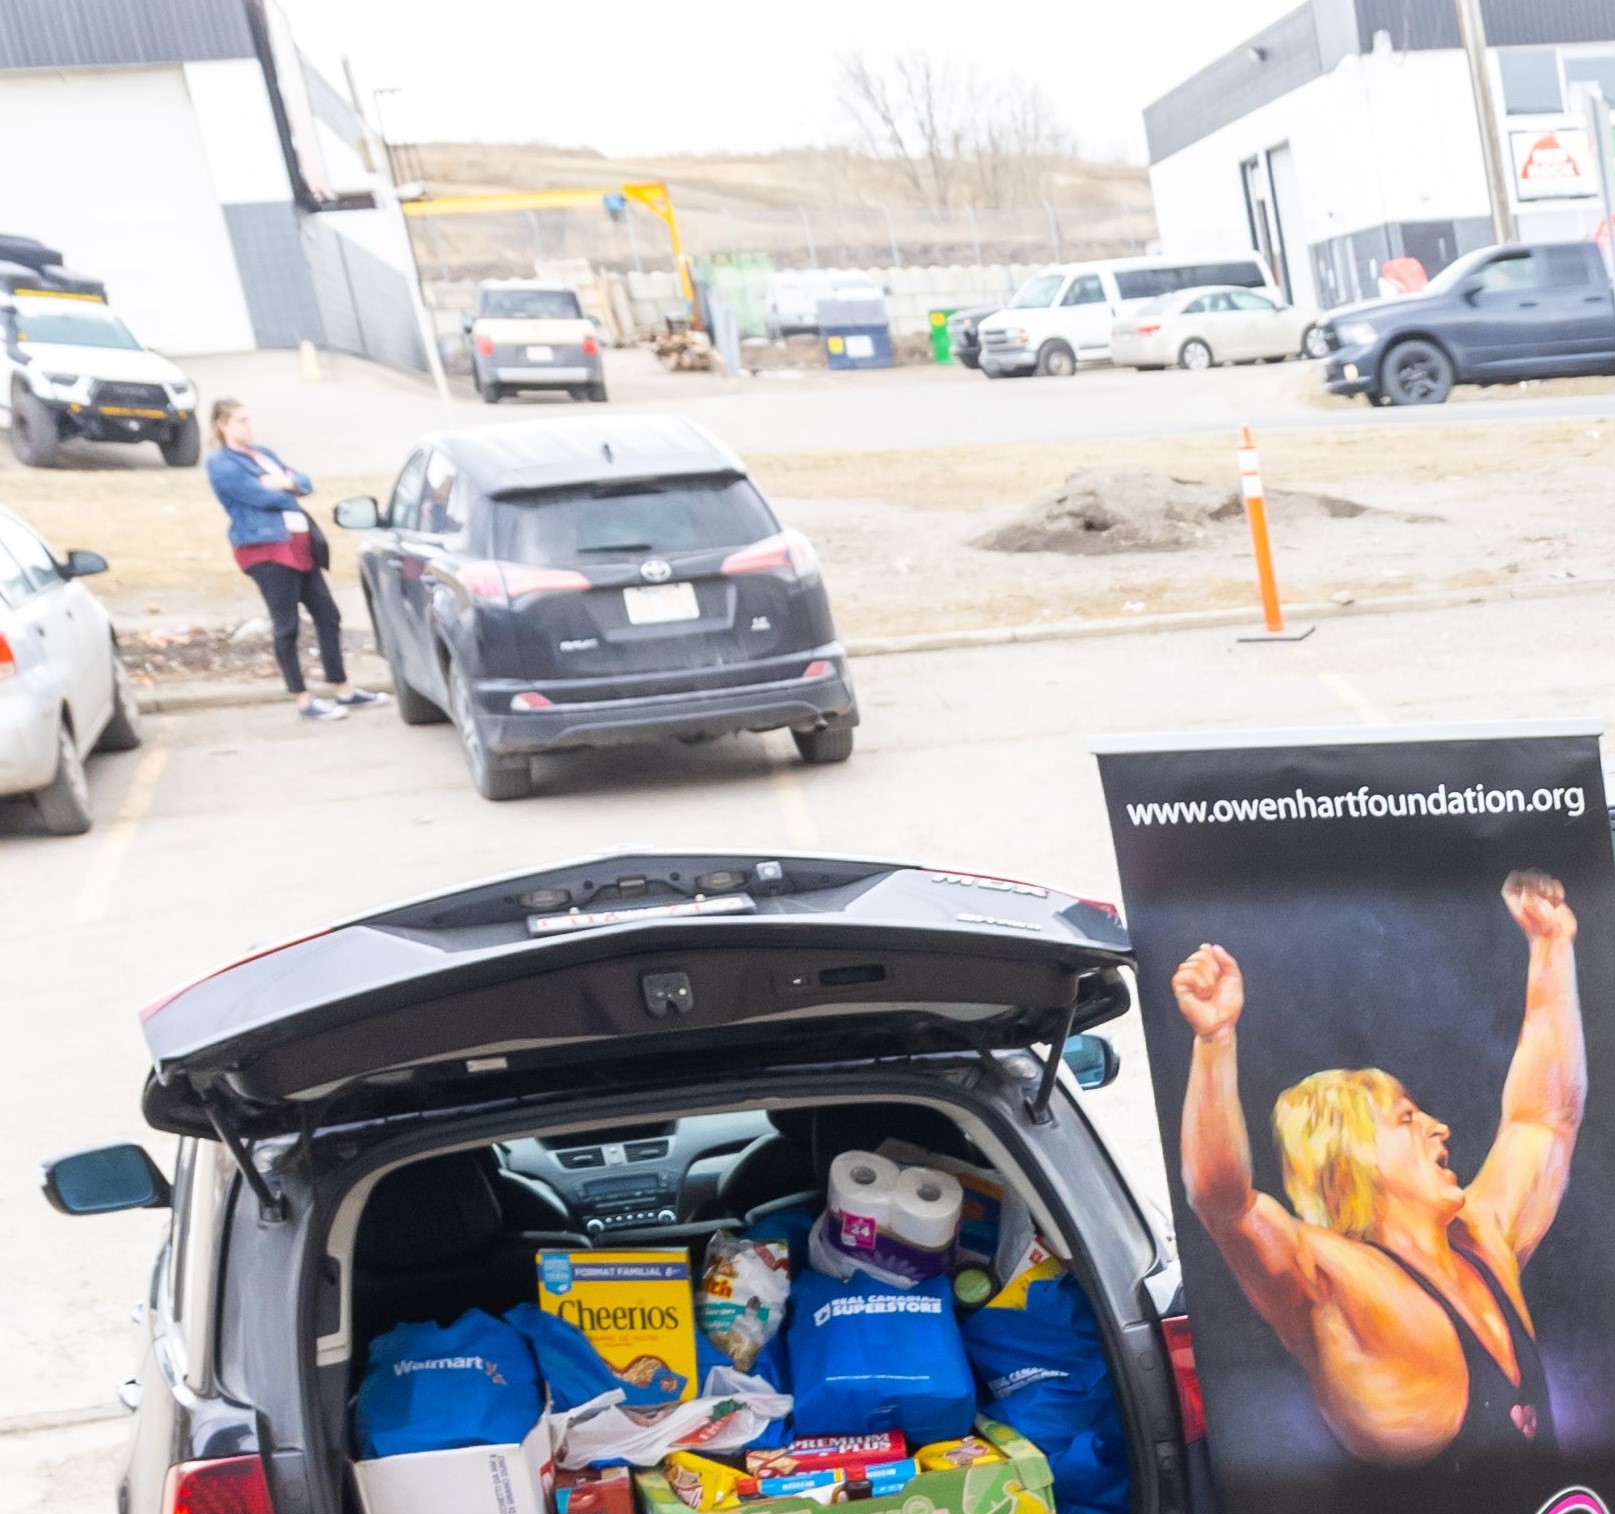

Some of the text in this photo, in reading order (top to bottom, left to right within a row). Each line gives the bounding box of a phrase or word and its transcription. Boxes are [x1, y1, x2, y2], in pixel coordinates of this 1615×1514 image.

[1125, 784, 1586, 827] www.owenhartfoundation.org
[557, 1299, 680, 1331] Cheerios
[832, 1301, 942, 1316] SUPERSTORE
[393, 1355, 484, 1376] Walmart
[788, 1432, 891, 1452] PREMIUM
[838, 1441, 892, 1454] PLUS
